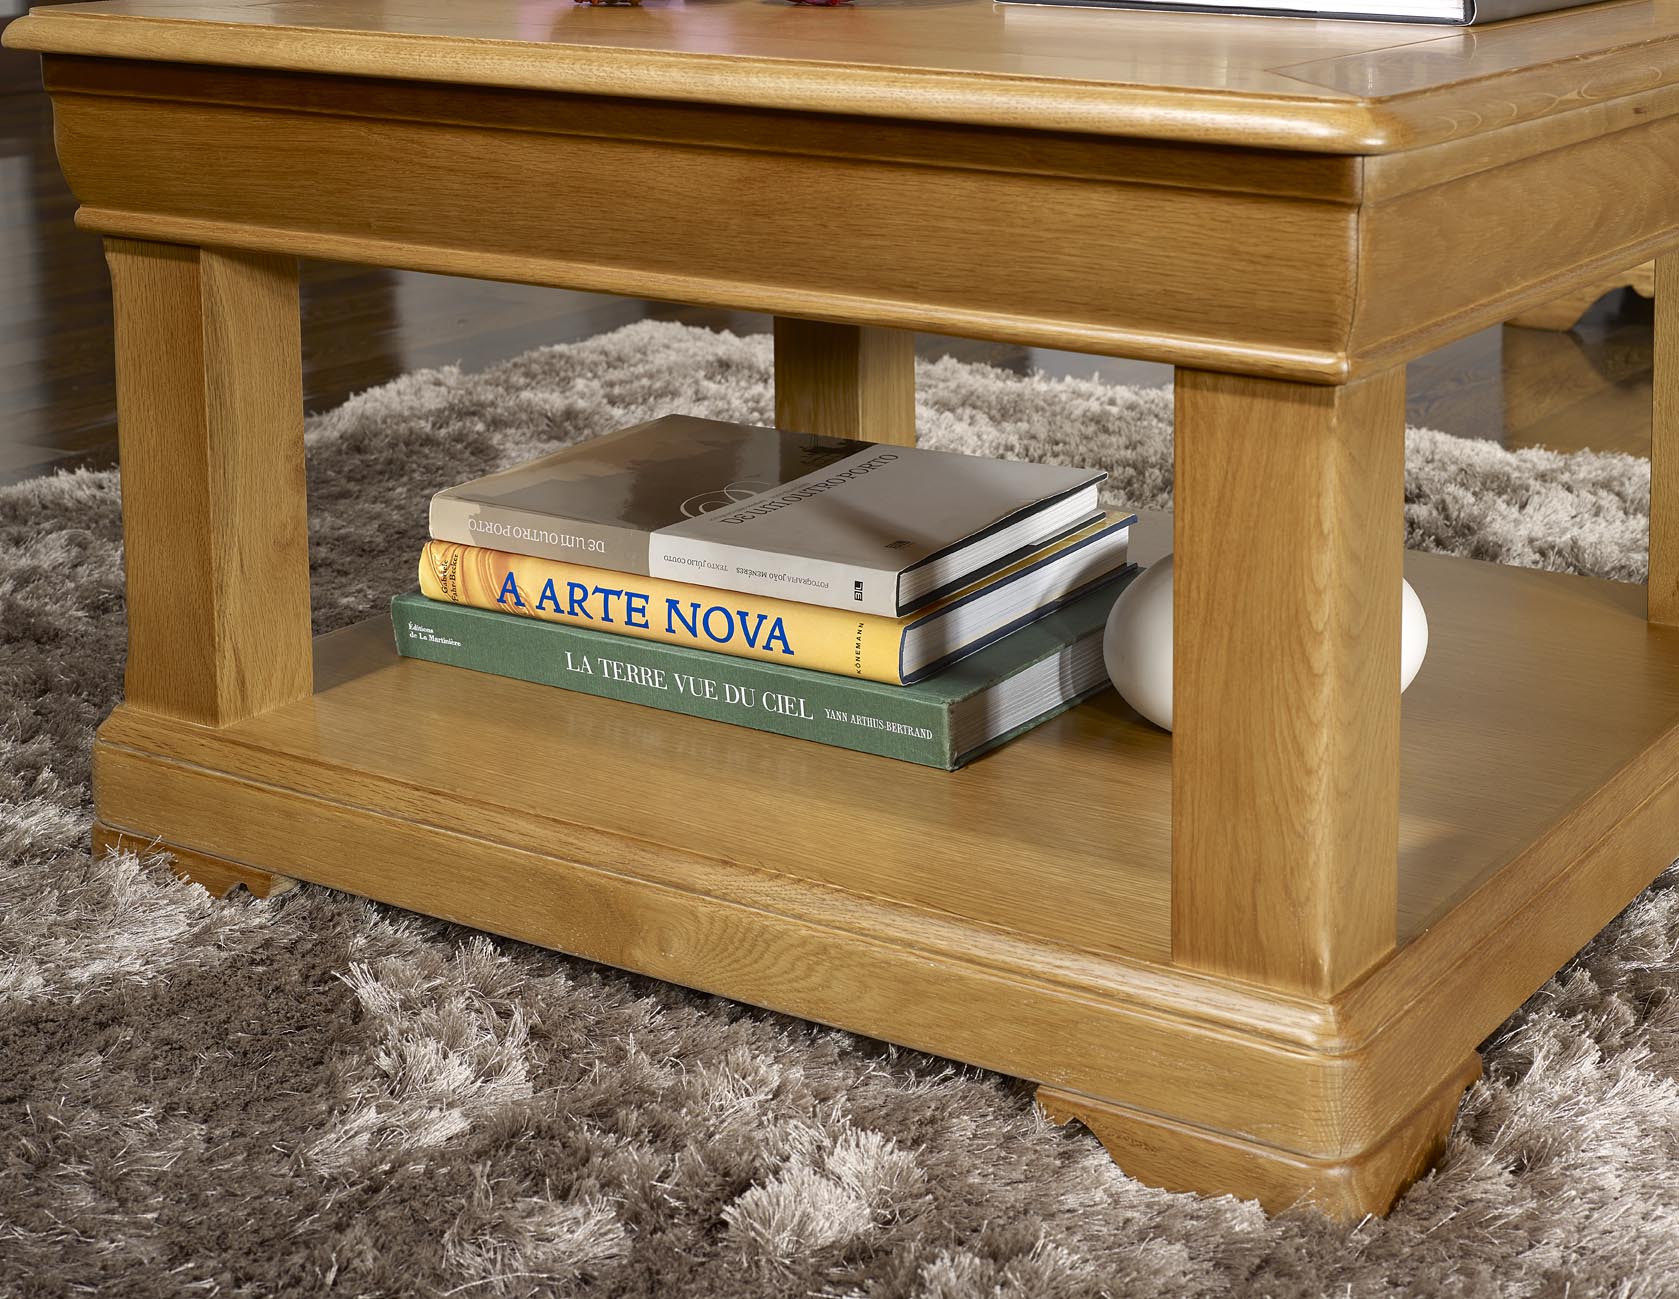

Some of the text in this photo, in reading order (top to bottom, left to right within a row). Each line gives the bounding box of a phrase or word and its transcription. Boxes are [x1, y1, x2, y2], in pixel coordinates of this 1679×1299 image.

[844, 453, 899, 480] PORTO
[468, 518, 511, 537] PORTO
[441, 560, 449, 594] Gabriele
[663, 554, 729, 572] TEXTO JÚLIO COUTO
[450, 553, 459, 603] Fahr-Becker
[735, 567, 829, 589] FOTOGRAFIA JOÃO MENÉRES
[497, 571, 795, 655] A ARTE NOVA
[418, 632, 428, 641] La
[428, 634, 462, 647] Martinière
[565, 651, 814, 720] LA TERRE VUE DU CIEL
[824, 708, 933, 740] YANN ARTHUS-BERTRAND
